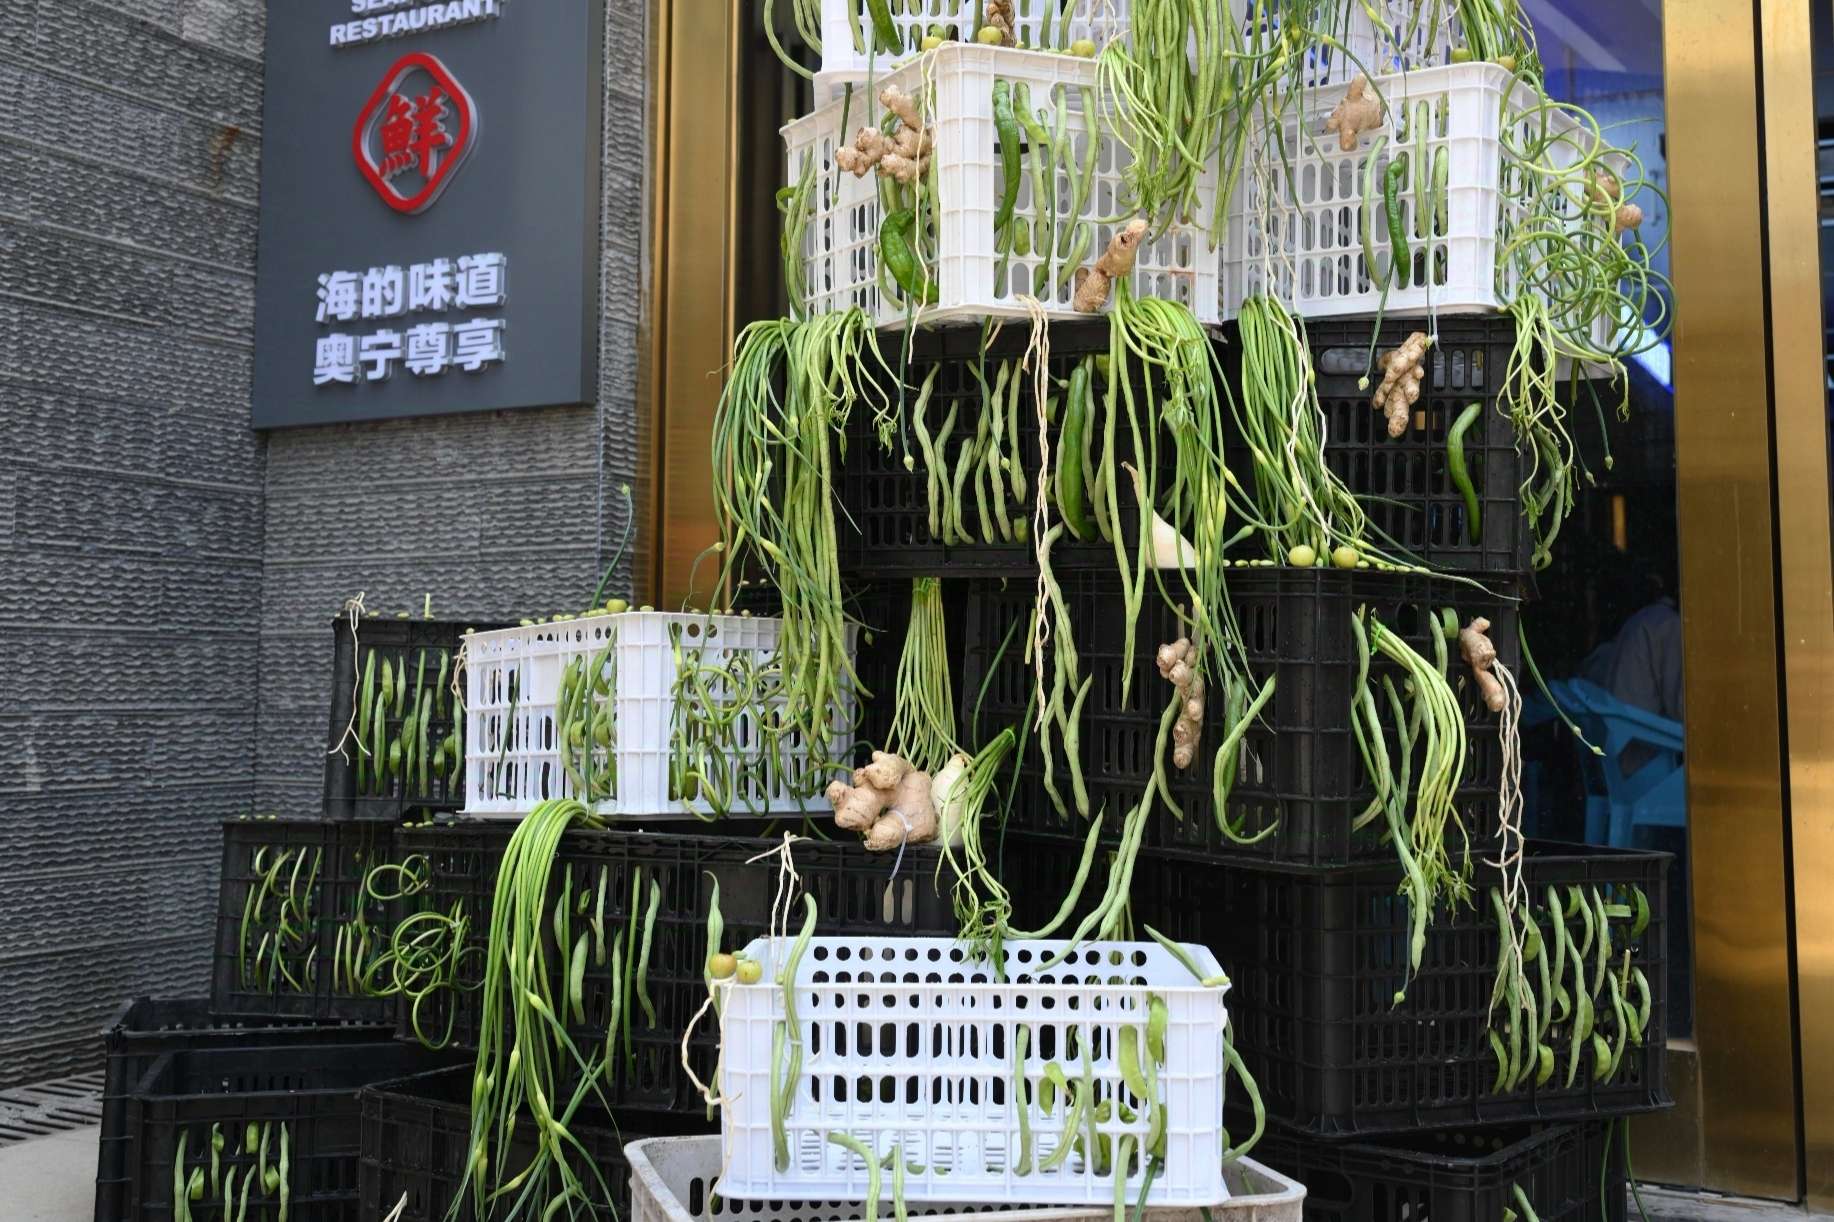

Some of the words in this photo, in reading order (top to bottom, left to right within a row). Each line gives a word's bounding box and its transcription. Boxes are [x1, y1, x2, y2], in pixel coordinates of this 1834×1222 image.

[329, 0, 496, 45] RESTAURANT
[378, 86, 447, 178] 鮮
[315, 252, 504, 323] 海的味道
[313, 318, 503, 385] 奥宁尊享
